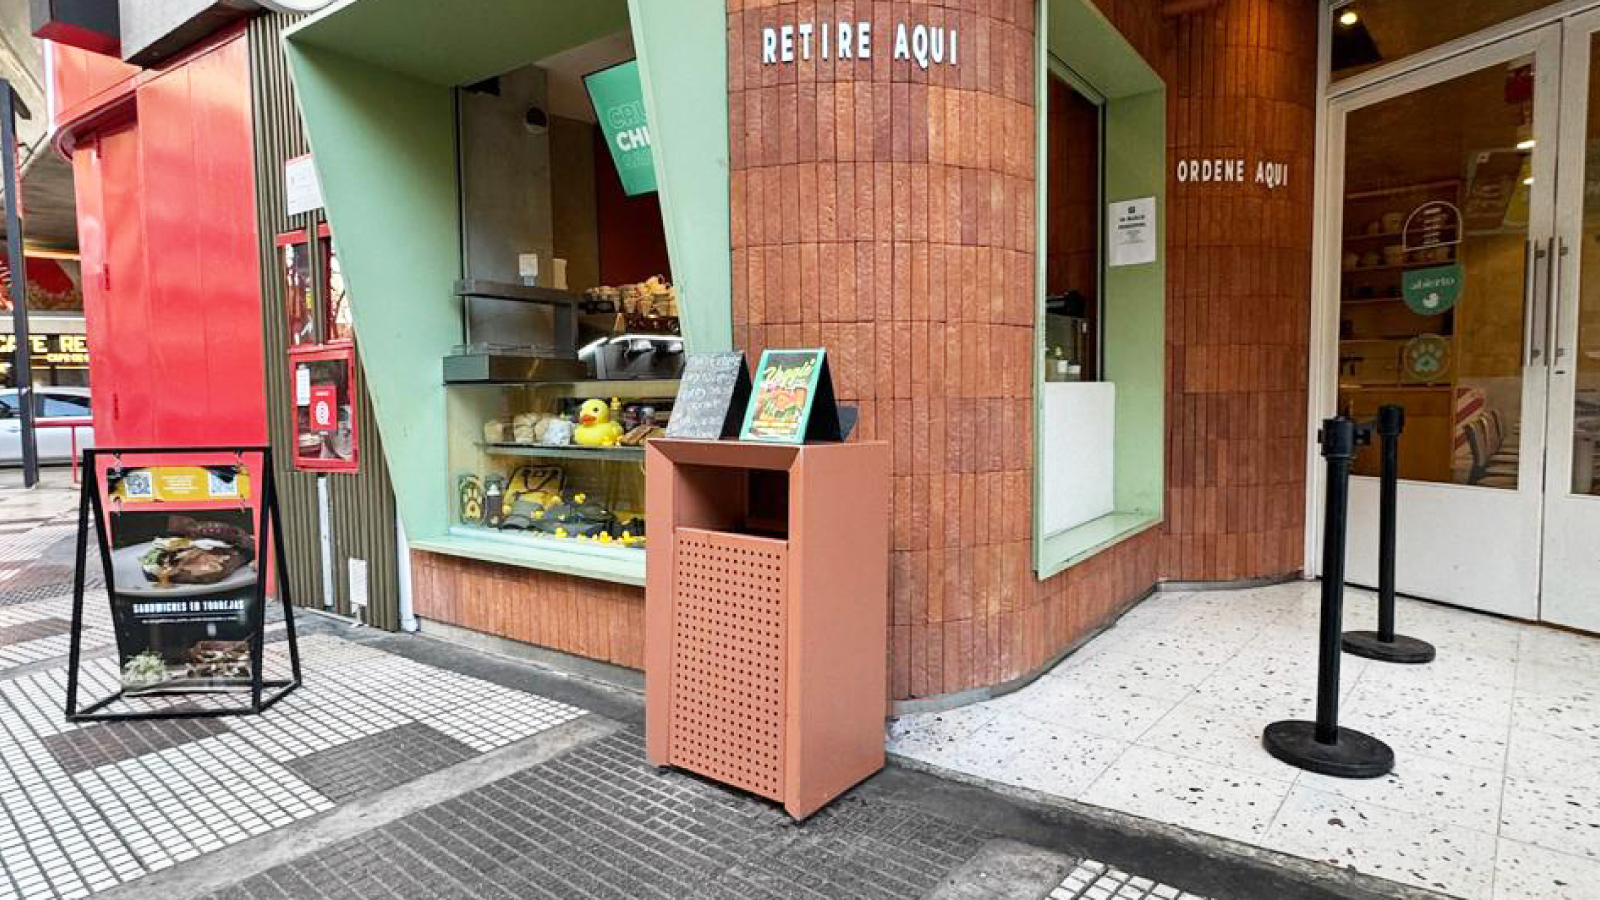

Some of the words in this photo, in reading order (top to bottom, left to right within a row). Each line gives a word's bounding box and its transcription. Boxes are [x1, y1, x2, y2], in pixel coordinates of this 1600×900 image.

[762, 21, 871, 64] RETIRE
[894, 23, 957, 69] AQUI
[1177, 159, 1245, 182] ORDENE
[1255, 161, 1288, 189] AQUI
